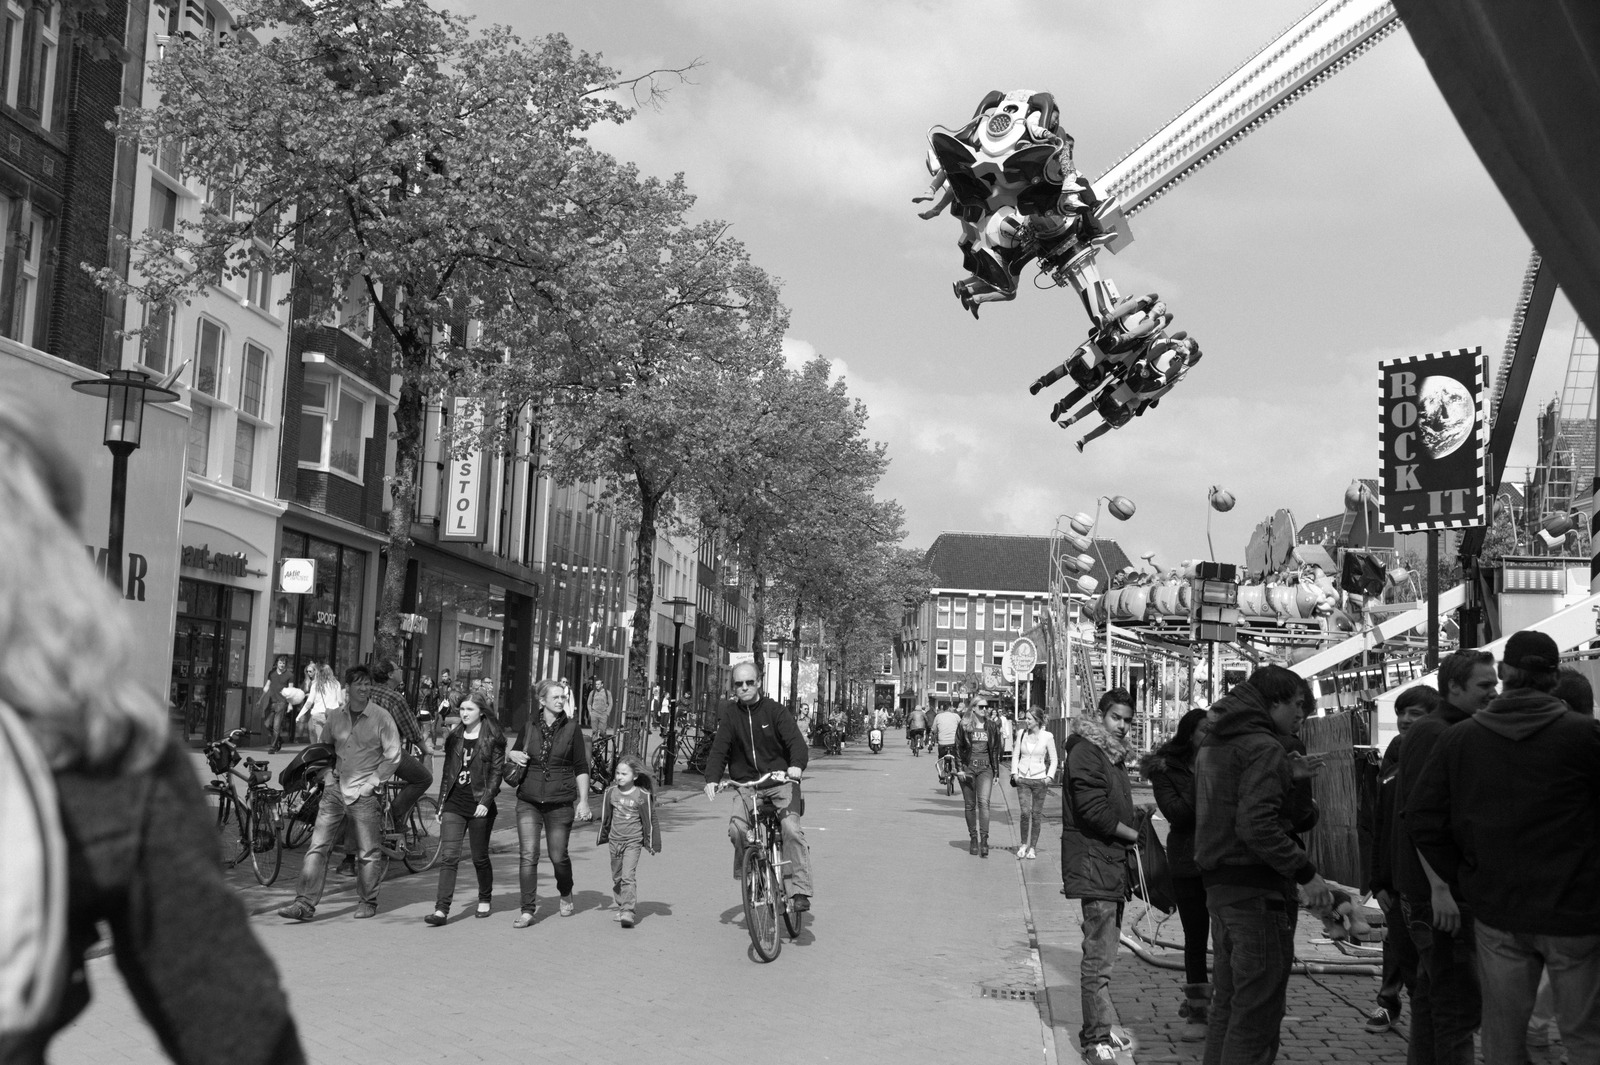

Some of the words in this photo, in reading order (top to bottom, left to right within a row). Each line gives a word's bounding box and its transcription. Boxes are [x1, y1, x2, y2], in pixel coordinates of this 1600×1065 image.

[1390, 371, 1422, 492] ROCK
[182, 544, 210, 570] art
[316, 611, 338, 627] SPORT
